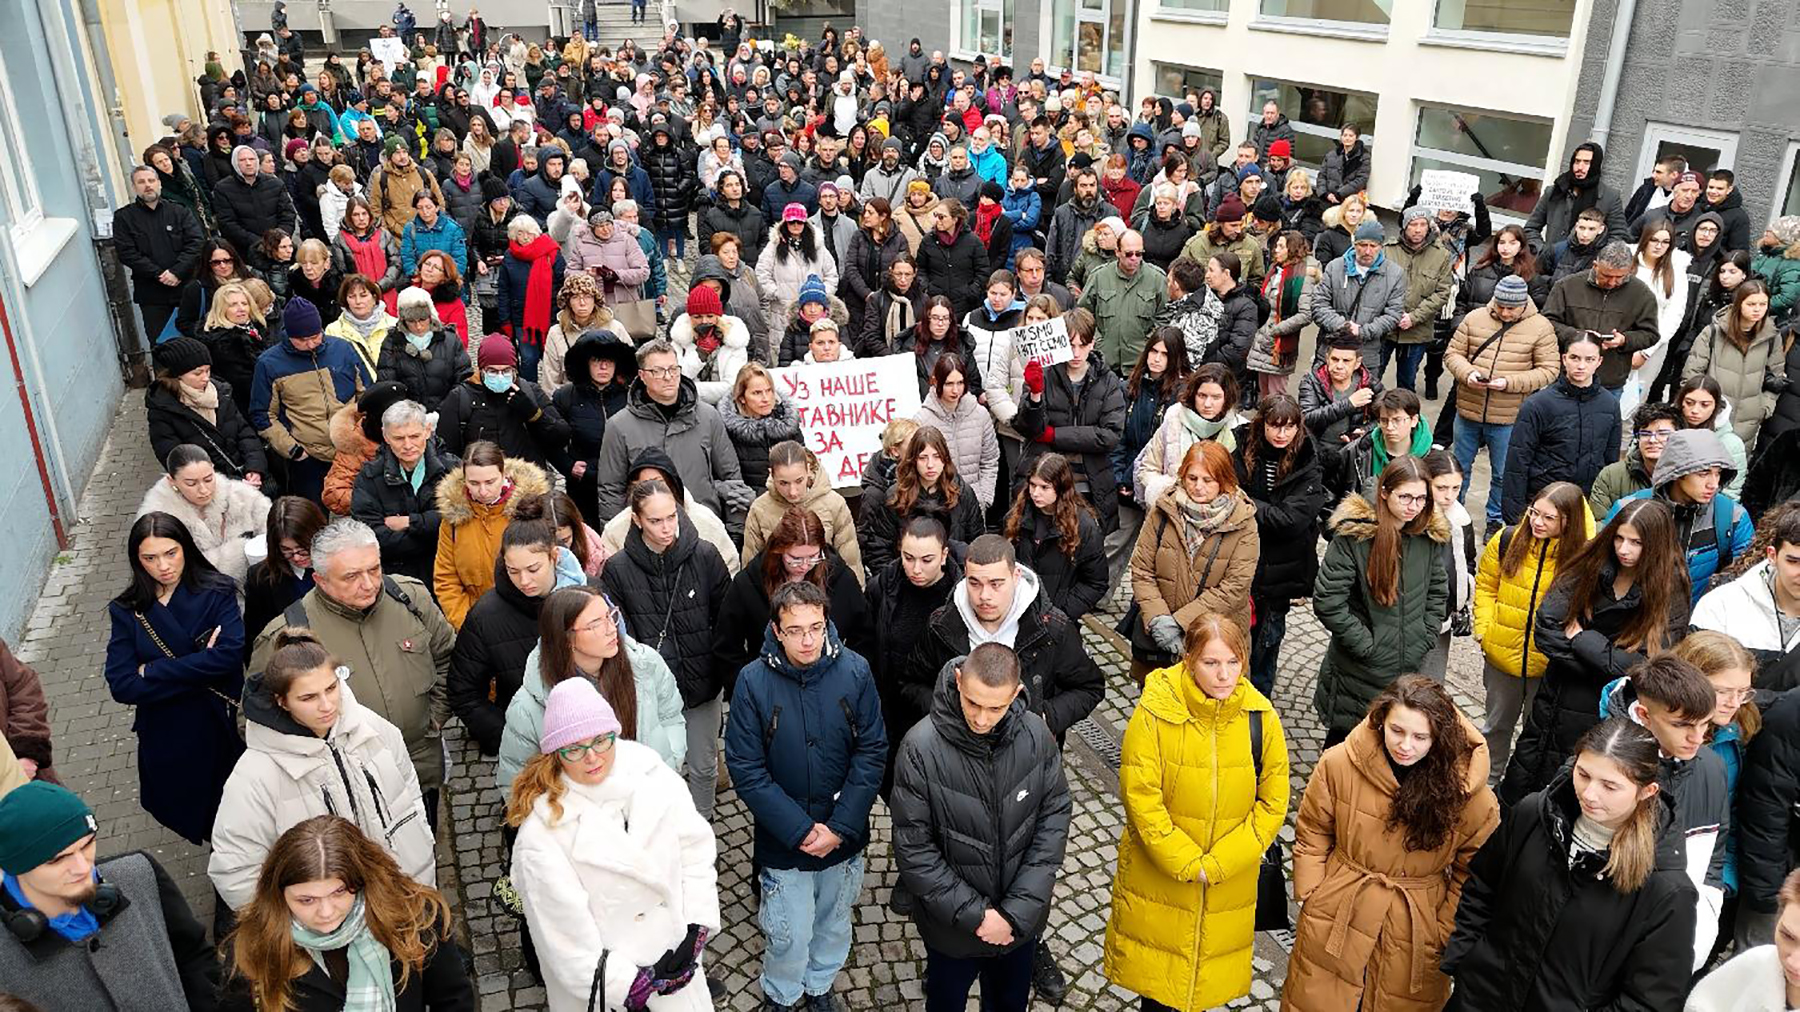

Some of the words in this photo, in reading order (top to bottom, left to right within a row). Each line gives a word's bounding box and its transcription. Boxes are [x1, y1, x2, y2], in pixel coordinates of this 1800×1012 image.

[1028, 322, 1053, 341] SMO
[820, 372, 880, 397] НАШЕ
[797, 399, 896, 428] ТАВНИКЕ
[814, 431, 843, 454] ЗА
[838, 452, 869, 480] ДЕ
